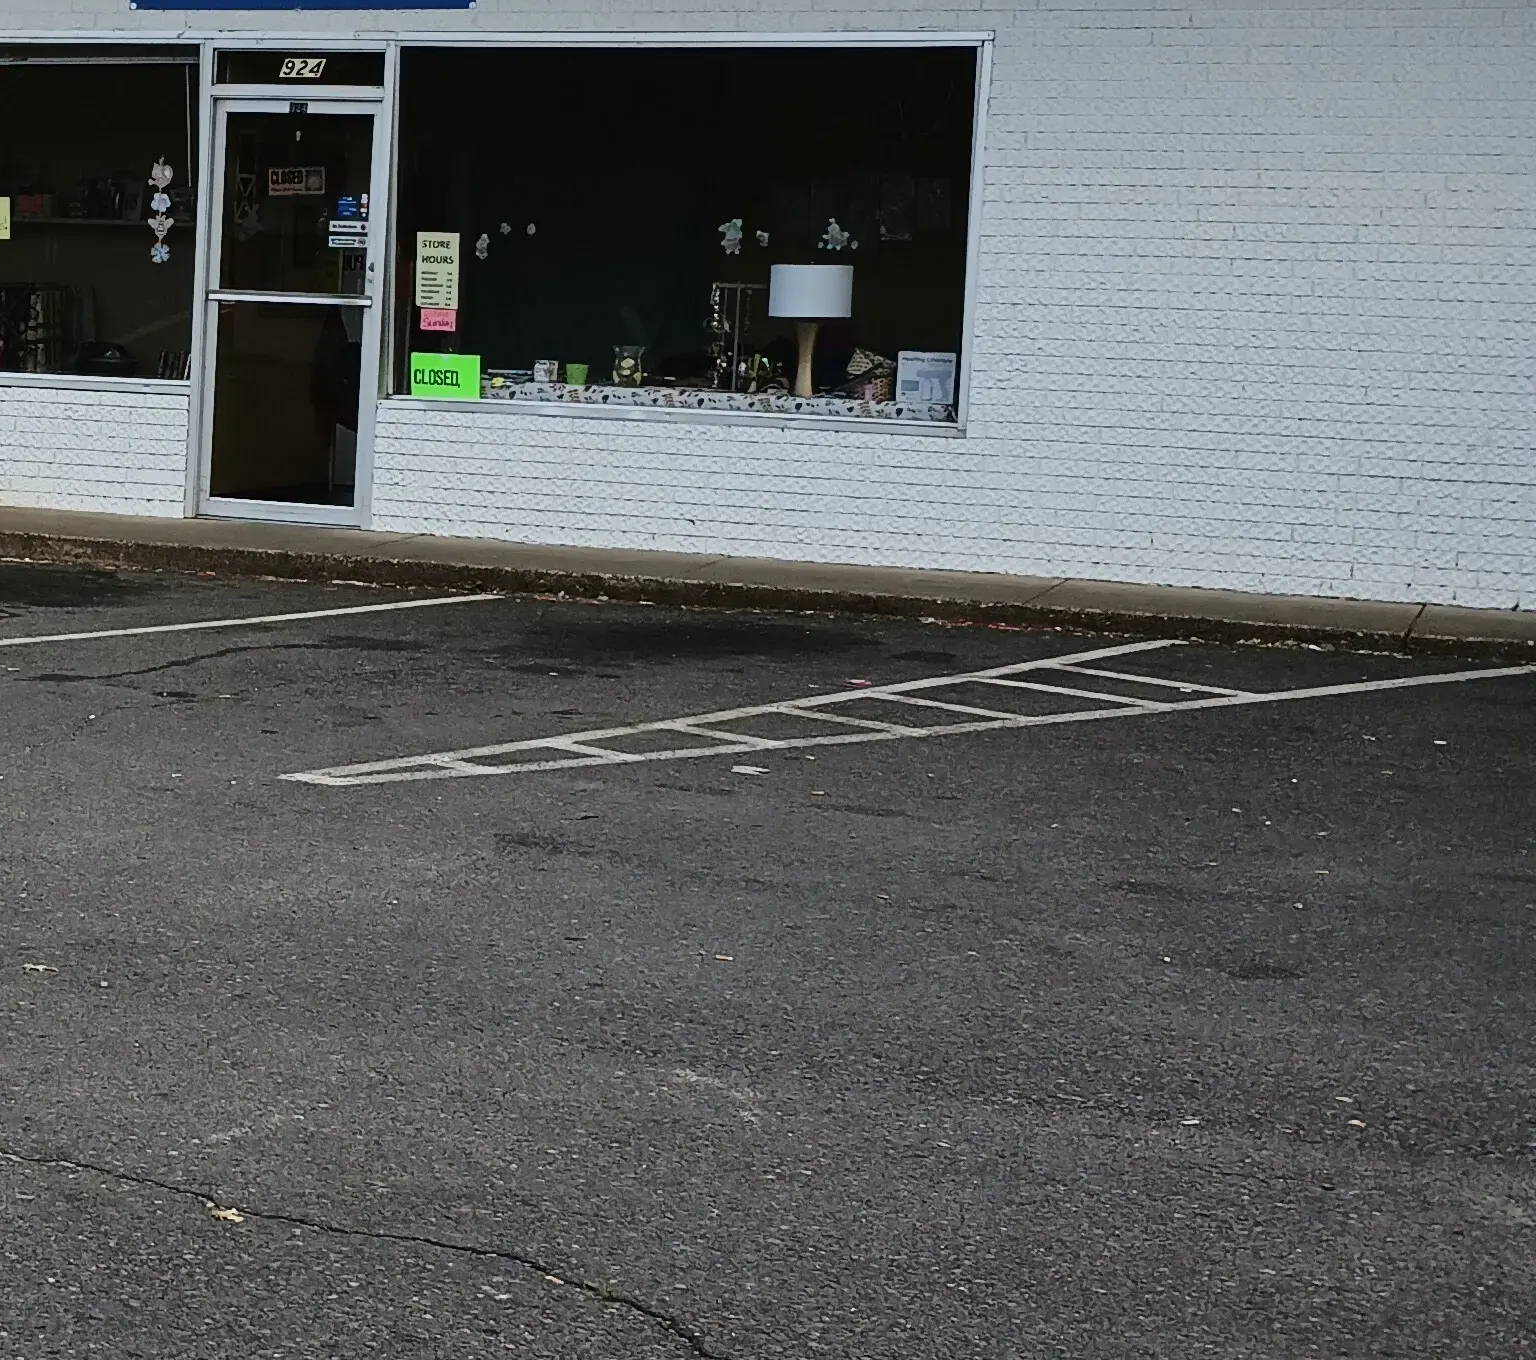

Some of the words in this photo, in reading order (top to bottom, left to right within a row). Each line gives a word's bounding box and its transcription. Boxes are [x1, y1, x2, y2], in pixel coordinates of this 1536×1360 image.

[282, 59, 324, 77] 924
[270, 170, 304, 185] CLOSED
[422, 240, 451, 249] STORE
[421, 255, 454, 264] HOURS
